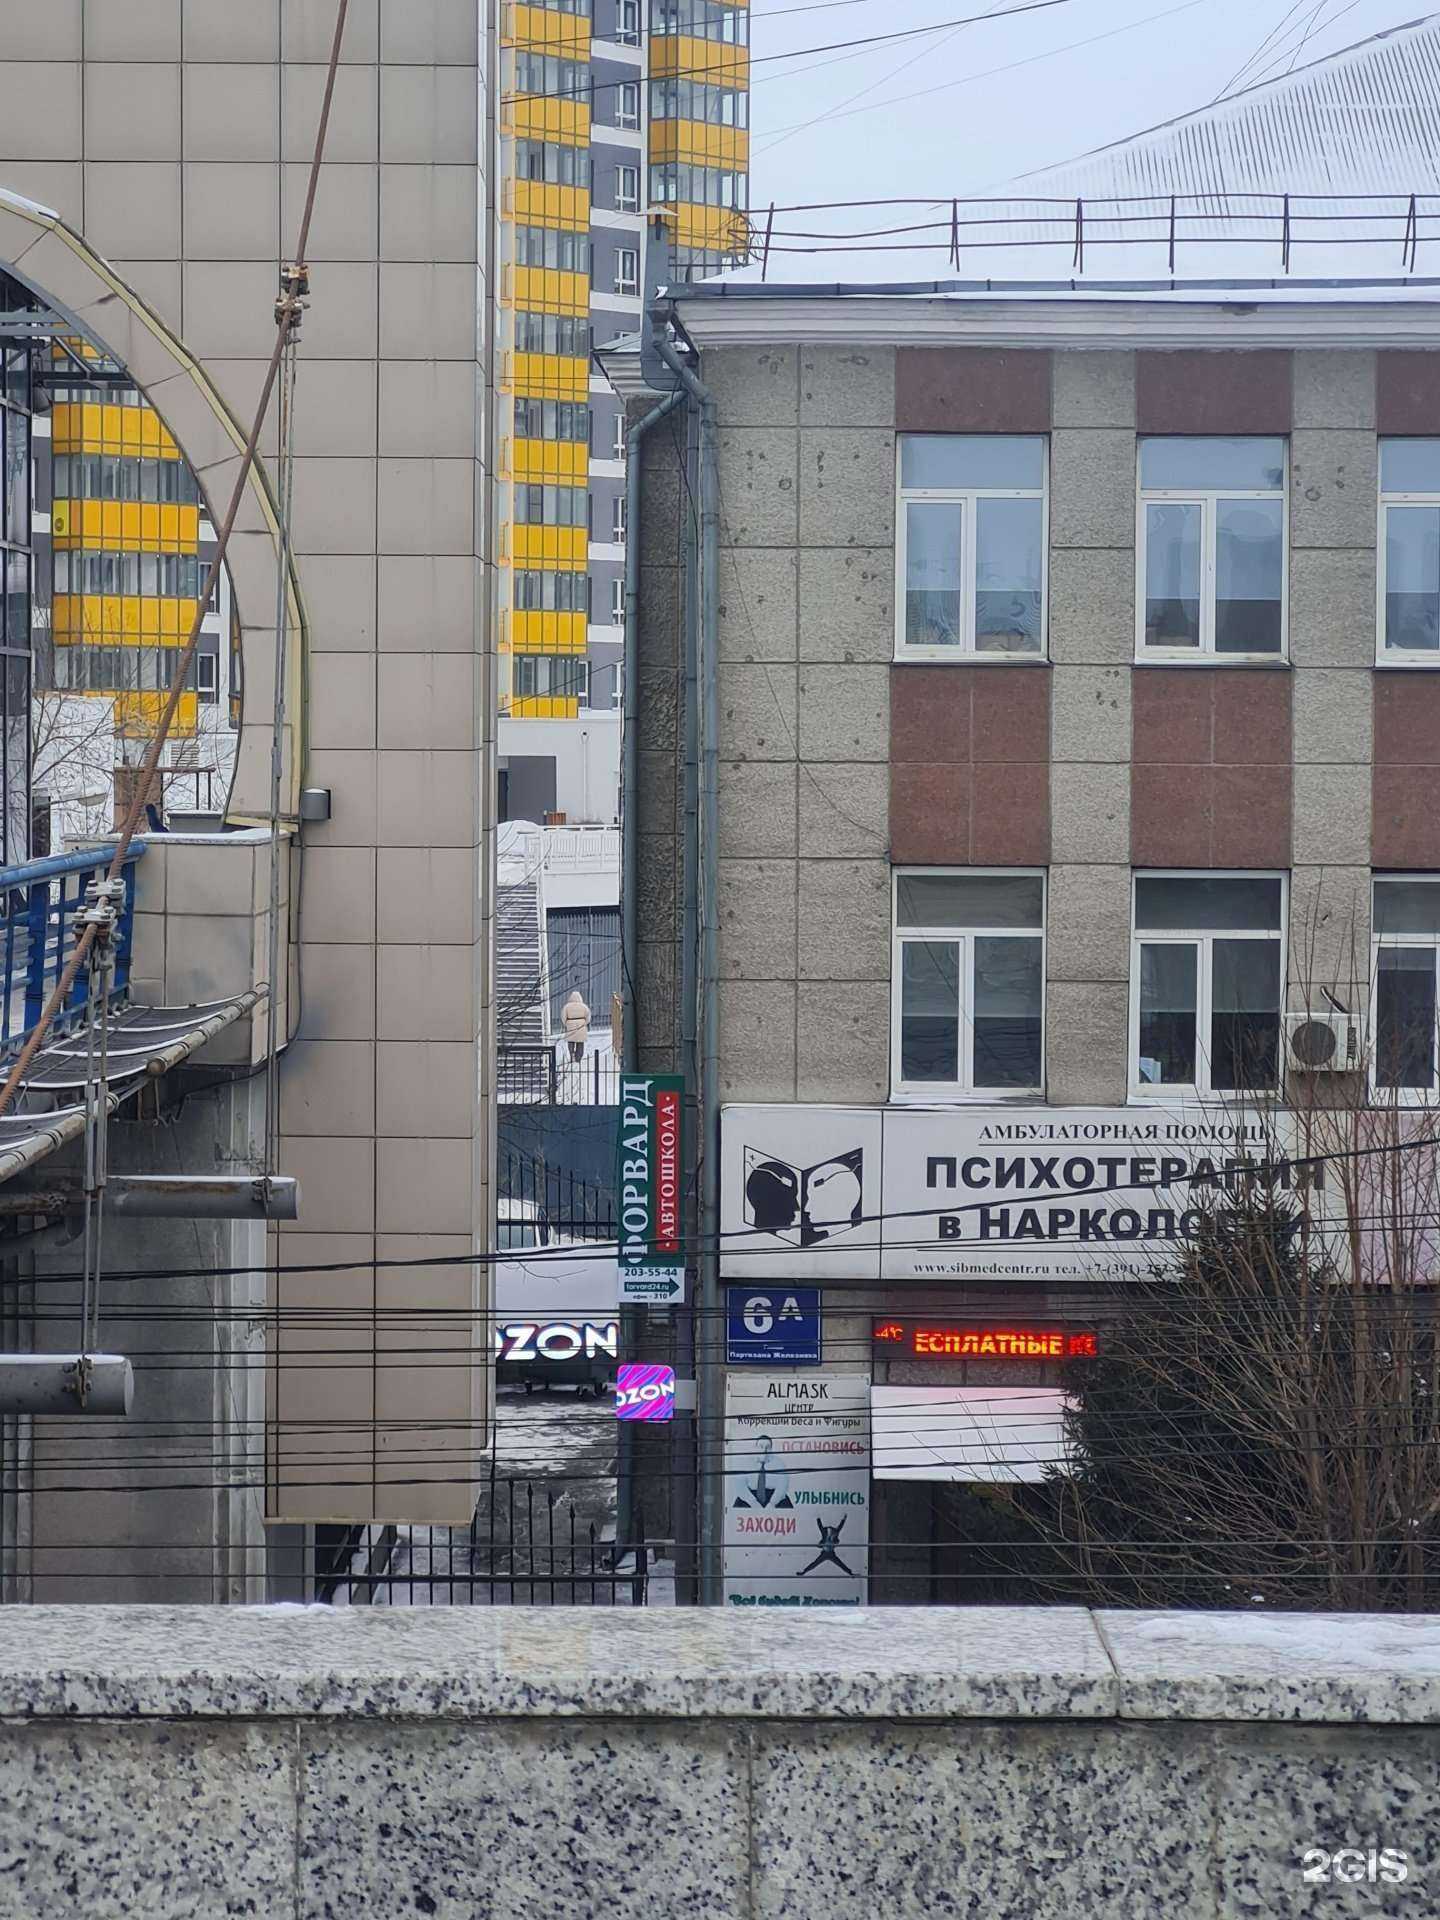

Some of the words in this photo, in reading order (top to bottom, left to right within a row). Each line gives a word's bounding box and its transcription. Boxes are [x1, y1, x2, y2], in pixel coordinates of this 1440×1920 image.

[979, 1124, 1158, 1140] АМБУЛАТОРНАЯ
[622, 1081, 654, 1264] ФОРВАРД
[661, 1104, 675, 1239] АВТОШКОЛА
[926, 1157, 1326, 1190] ПСИХОТЕРАПИЯ
[624, 1268, 678, 1276] 203-55-44
[913, 1262, 1050, 1275] www.sibmedcentr.ru
[767, 1383, 829, 1399] ALMASK
[782, 1439, 865, 1455] ОСТАНОВИСЬ
[794, 1491, 865, 1505] УЛЫБНИСЬ
[736, 1517, 796, 1536] ЗАХОДИ
